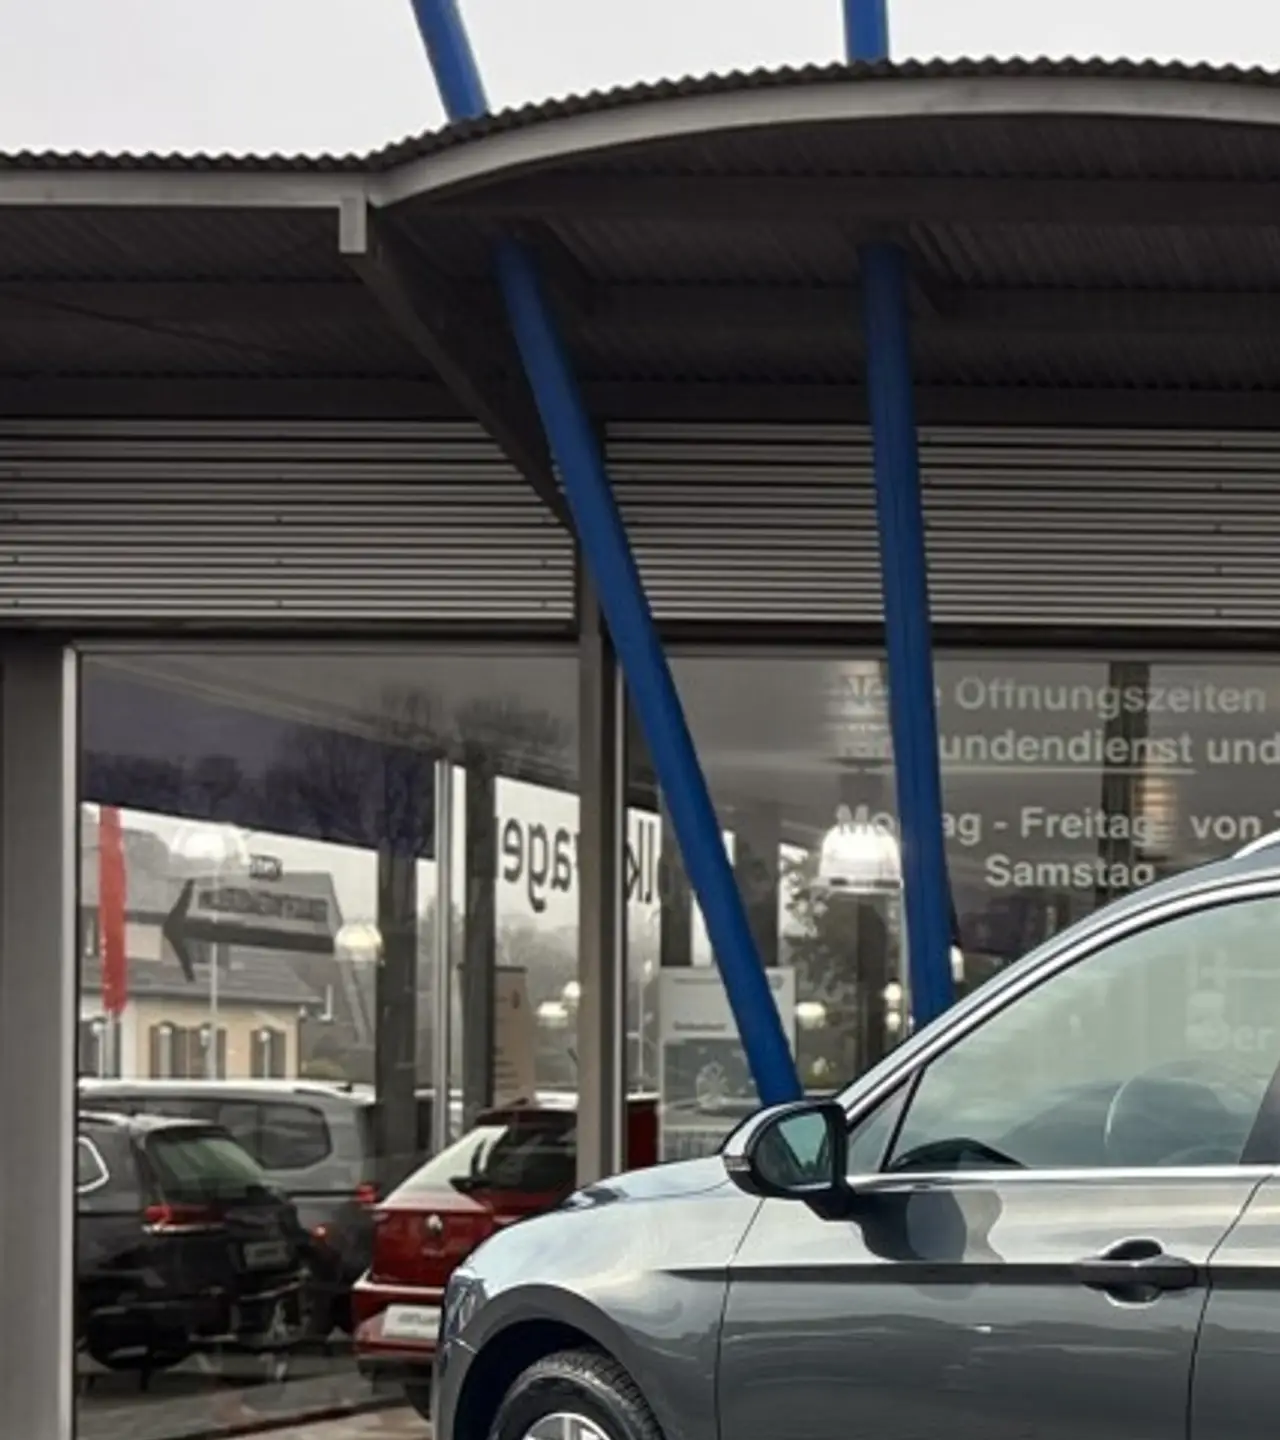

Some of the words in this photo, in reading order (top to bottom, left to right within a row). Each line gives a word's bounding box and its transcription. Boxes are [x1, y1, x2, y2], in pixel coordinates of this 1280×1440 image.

[938, 729, 1194, 764] undendienst
[1020, 806, 1154, 848] Freitag
[1189, 814, 1262, 840] von
